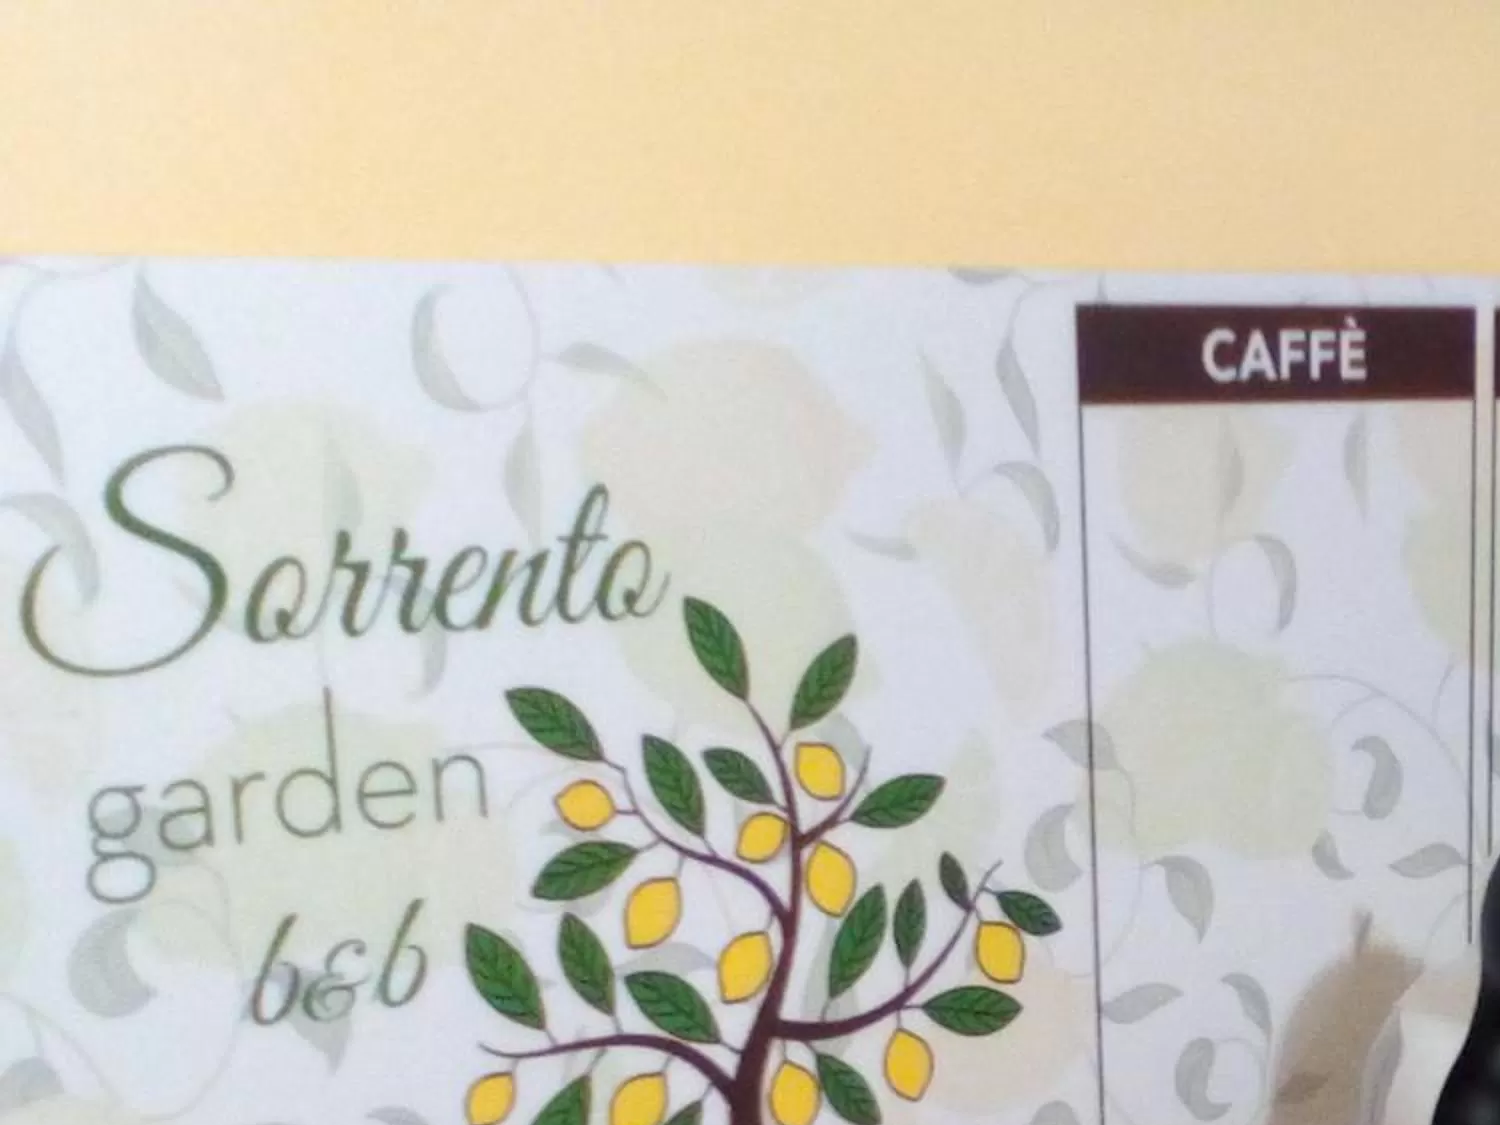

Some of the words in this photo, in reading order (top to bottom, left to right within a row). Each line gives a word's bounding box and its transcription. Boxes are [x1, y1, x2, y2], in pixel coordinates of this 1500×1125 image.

[1201, 316, 1367, 382] CAFFÈ
[20, 444, 671, 677] Sorrento
[86, 686, 488, 904] garden
[250, 898, 428, 1026] b&b
